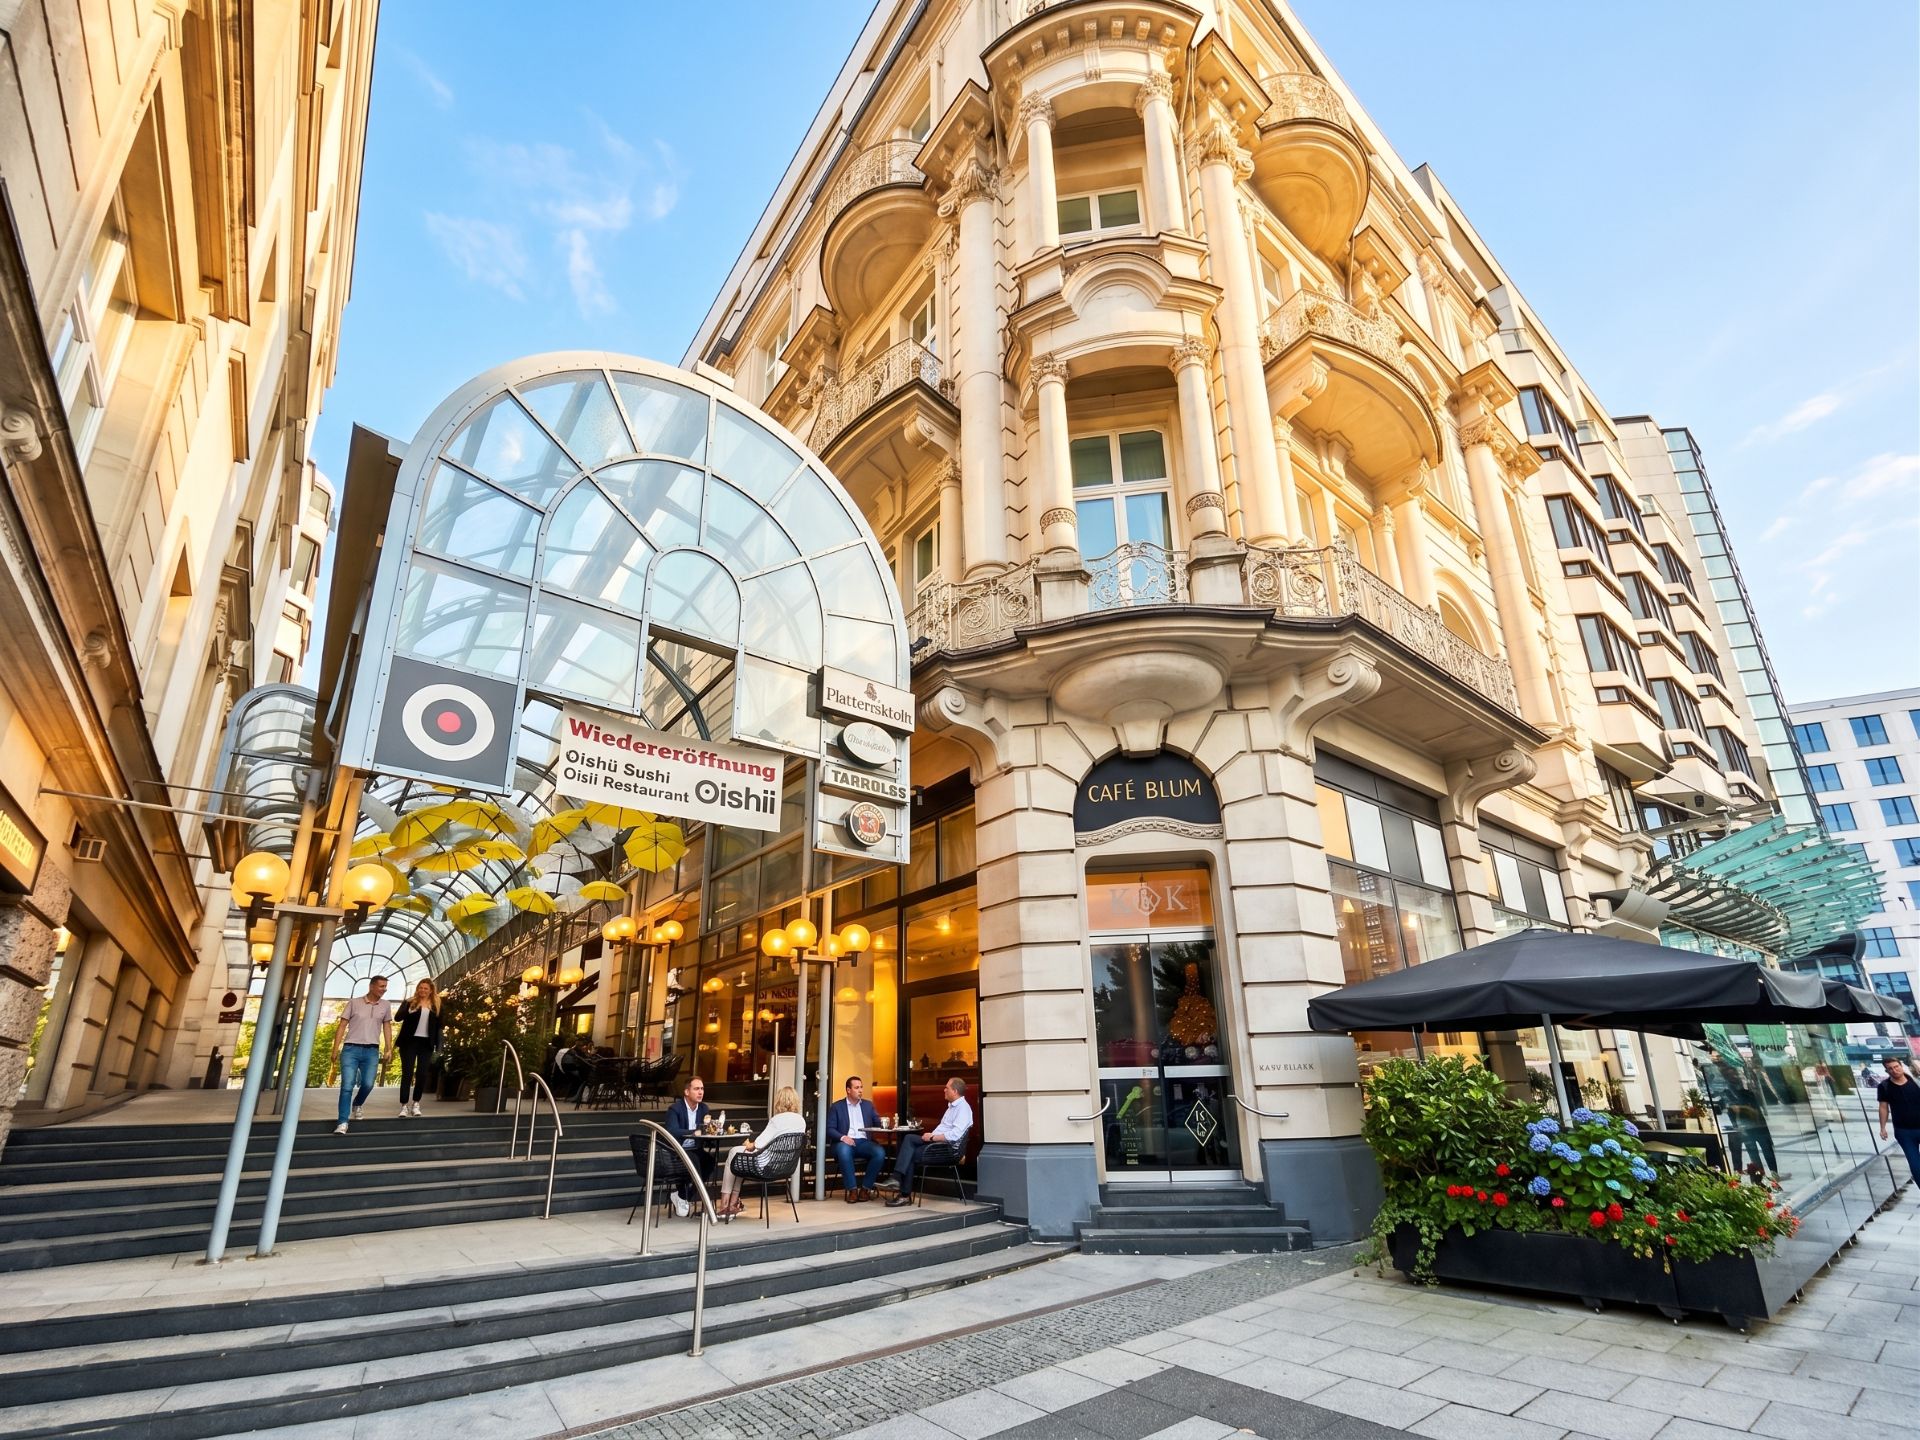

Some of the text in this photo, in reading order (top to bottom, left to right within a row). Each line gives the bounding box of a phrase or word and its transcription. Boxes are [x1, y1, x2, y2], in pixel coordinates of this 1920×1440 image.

[569, 717, 776, 782] Wiedereröffnung
[563, 767, 690, 803] Oisii Restaurant
[623, 763, 670, 784] Sushi
[831, 770, 907, 799] TARROLSS
[695, 779, 776, 815] Oishii
[1088, 778, 1202, 803] CAFÉ BLUM
